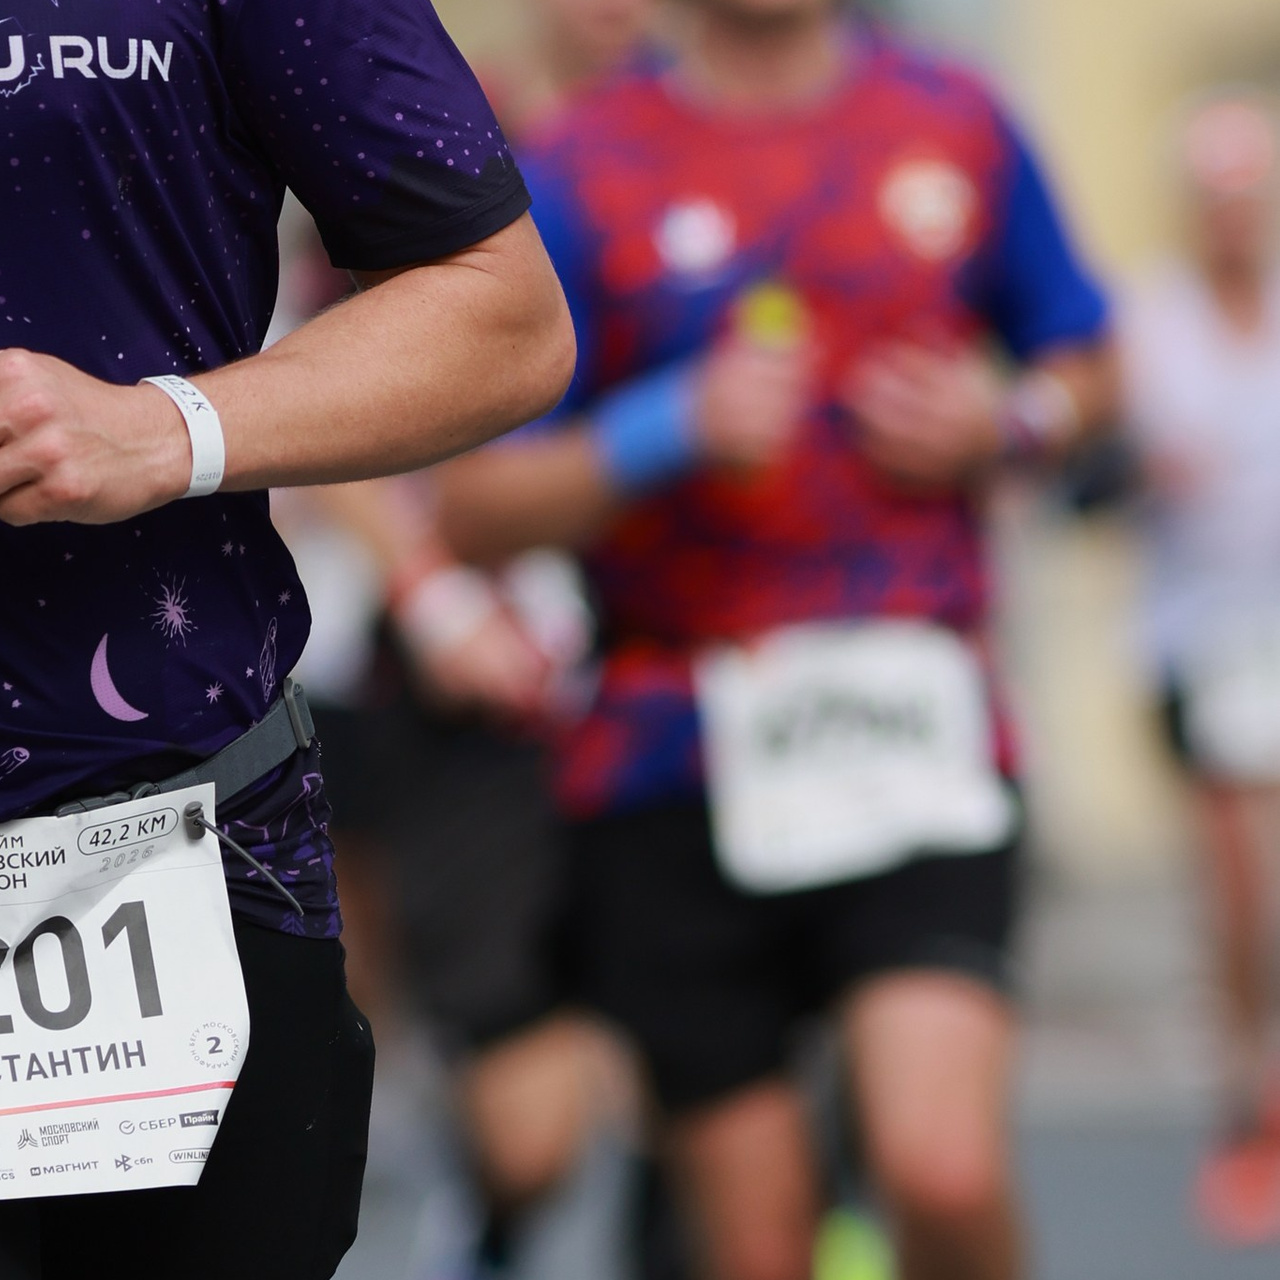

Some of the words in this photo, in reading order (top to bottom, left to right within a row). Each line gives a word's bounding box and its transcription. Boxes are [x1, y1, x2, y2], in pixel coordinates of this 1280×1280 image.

[49, 35, 174, 81] RUN
[89, 824, 130, 847] 42,2
[206, 1036, 223, 1054] 2
[39, 1118, 100, 1136] МОСКОВСКИЙ
[139, 1117, 177, 1131] СБЕР
[184, 1113, 215, 1124] Прайм
[41, 1134, 69, 1147] СПОРТ
